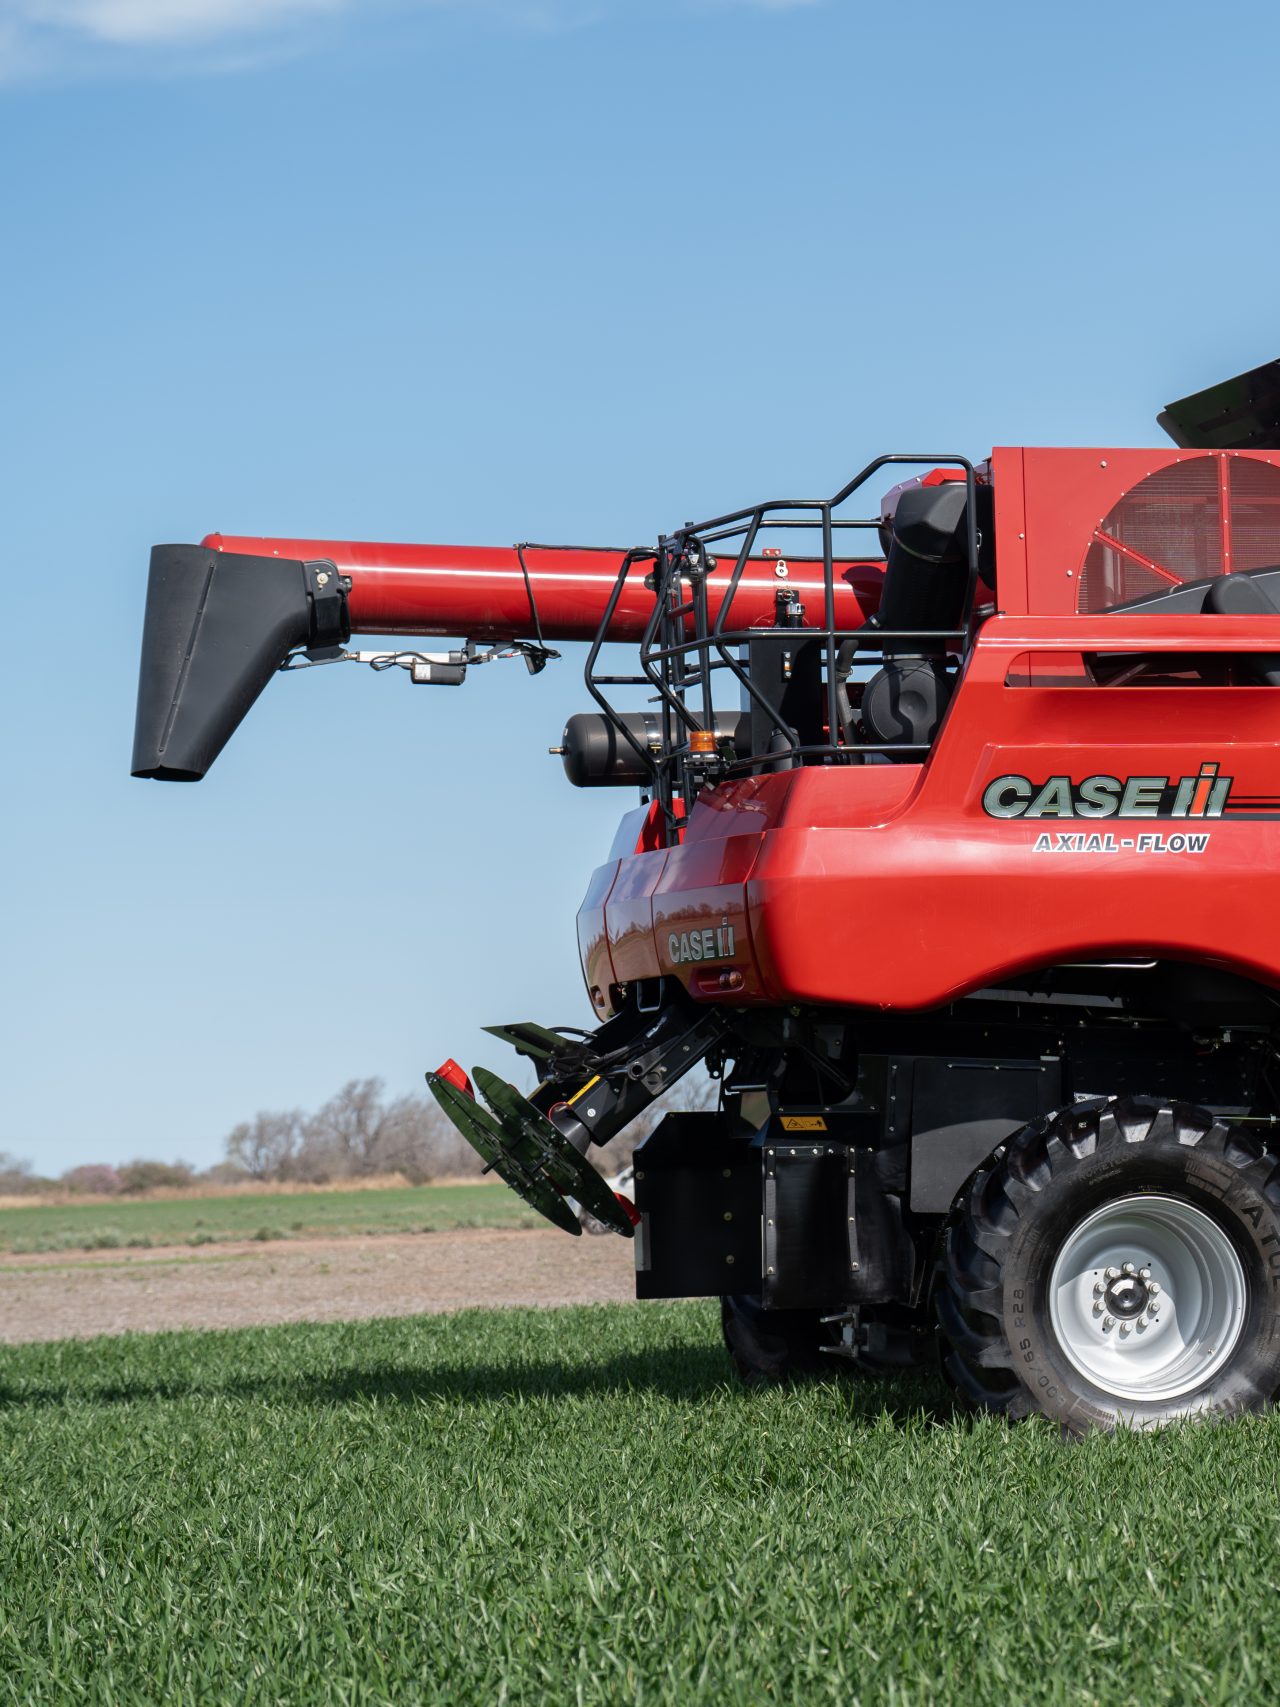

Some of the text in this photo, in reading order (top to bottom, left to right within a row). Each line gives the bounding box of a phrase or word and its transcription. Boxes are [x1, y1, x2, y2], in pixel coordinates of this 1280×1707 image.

[982, 775, 1167, 819] CASE
[1032, 833, 1211, 853] AXIAL-FLOW
[668, 929, 716, 963] CASE
